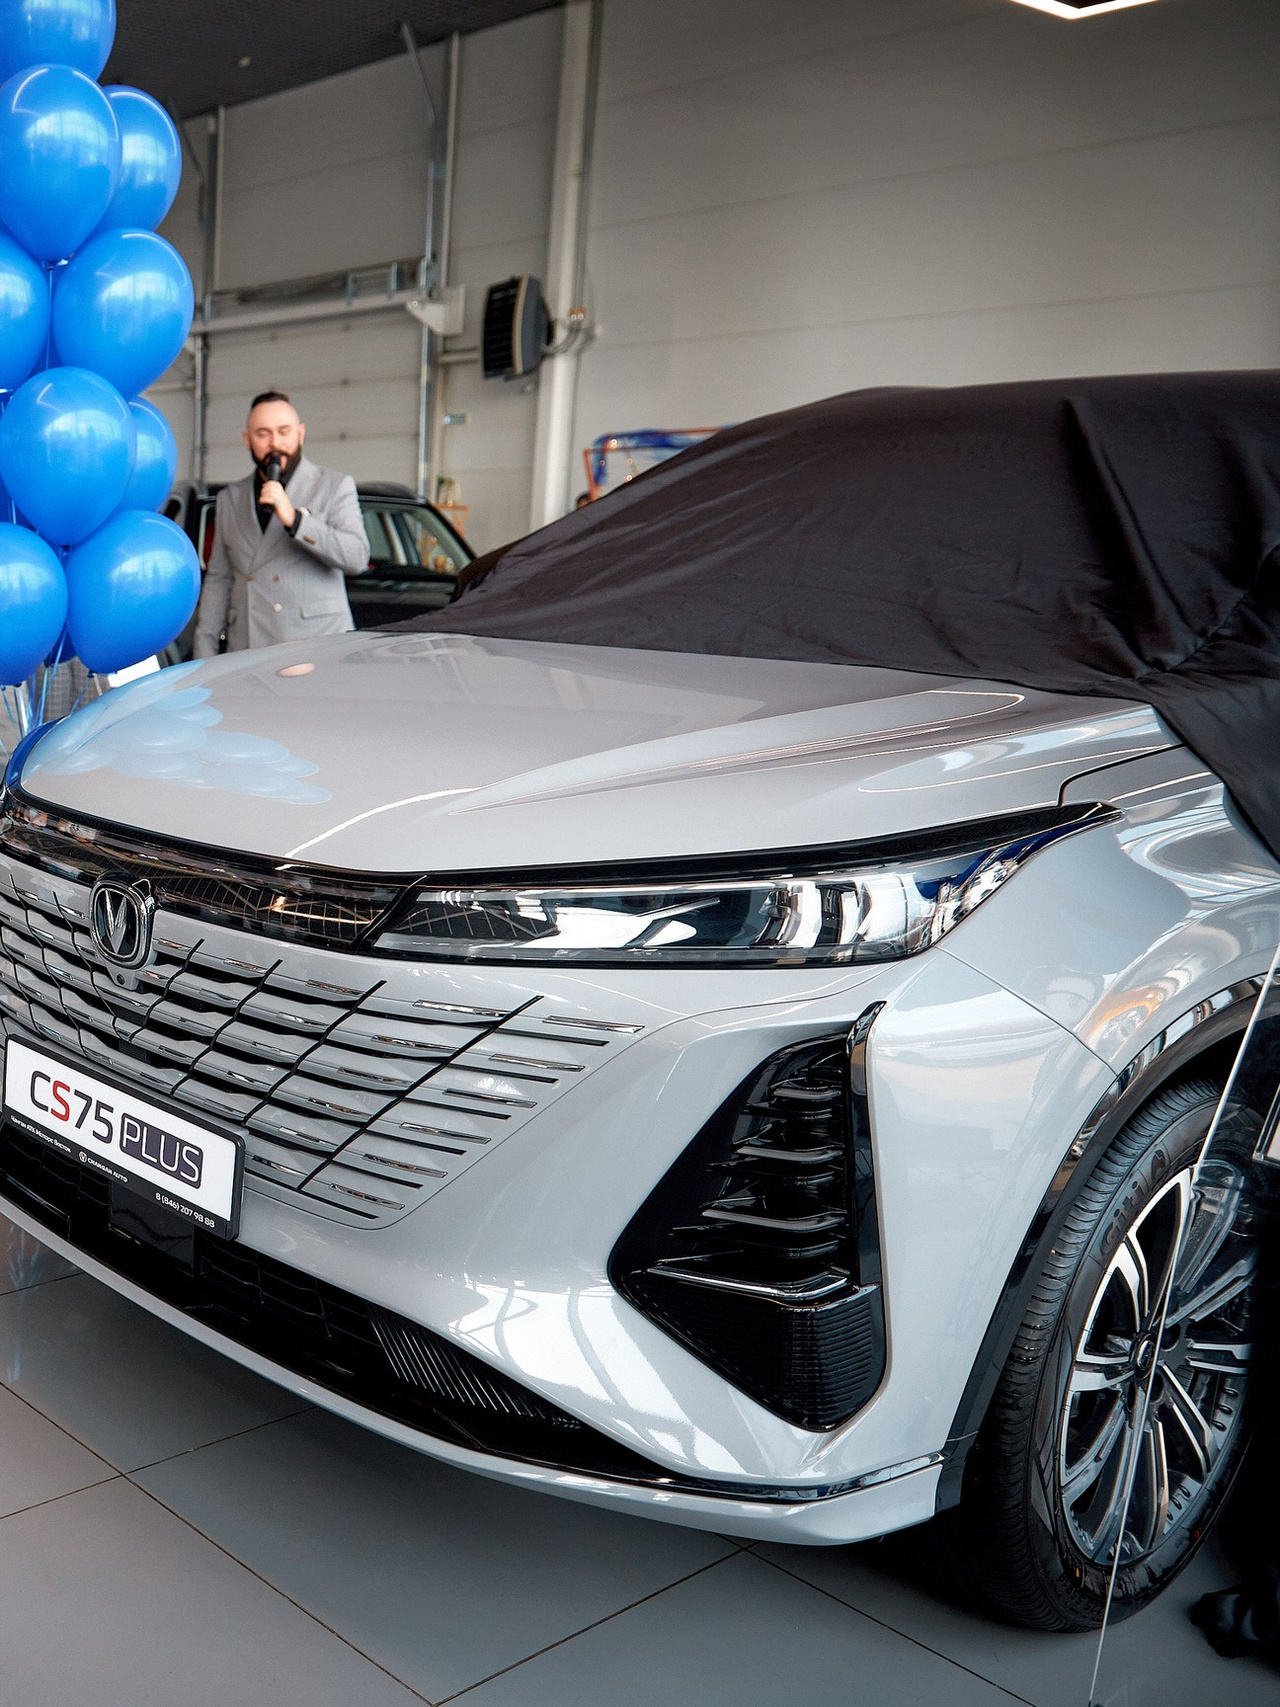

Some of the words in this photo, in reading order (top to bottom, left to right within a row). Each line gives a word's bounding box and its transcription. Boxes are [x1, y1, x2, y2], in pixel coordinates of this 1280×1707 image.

[30, 1070, 114, 1145] CS75
[122, 1117, 200, 1184] PLUS
[155, 1192, 161, 1201] 8
[161, 1194, 180, 1211] (846)
[180, 1204, 194, 1217] 207
[204, 1217, 215, 1228] 88
